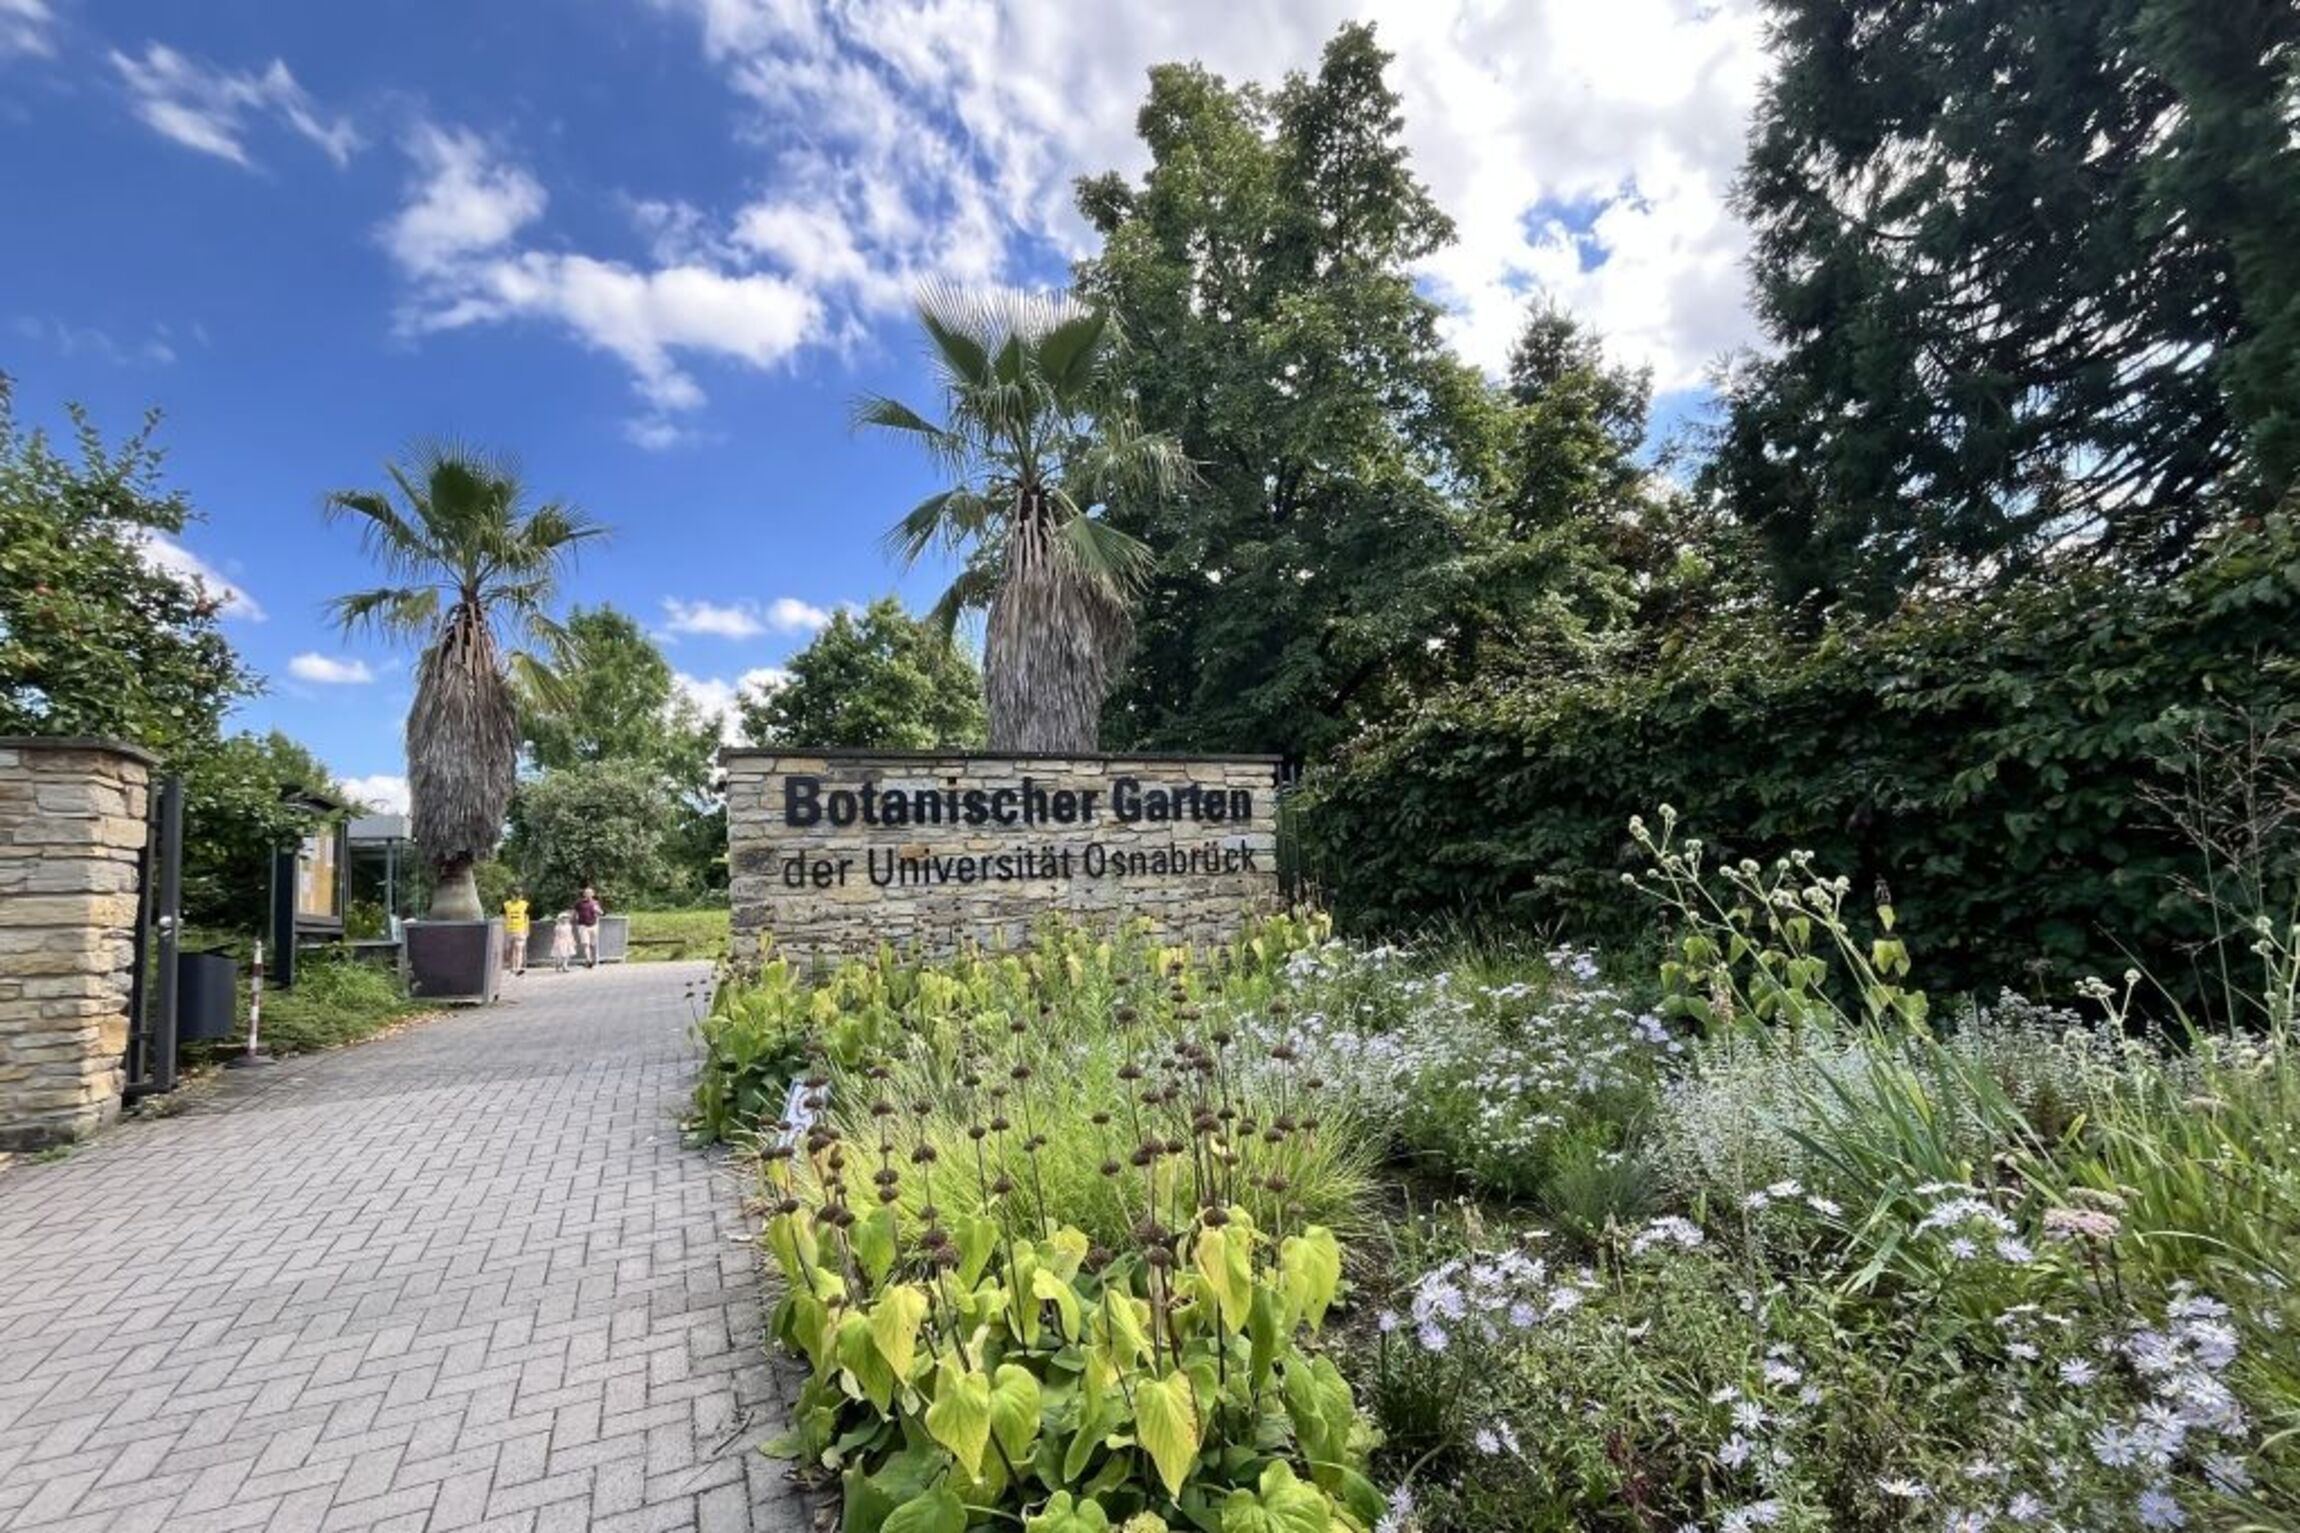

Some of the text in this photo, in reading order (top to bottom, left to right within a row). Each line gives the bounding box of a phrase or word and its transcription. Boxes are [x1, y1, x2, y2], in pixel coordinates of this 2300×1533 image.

[785, 777, 1253, 827] Botanischer Garten
[784, 840, 1258, 888] der Universität Osnabrück
